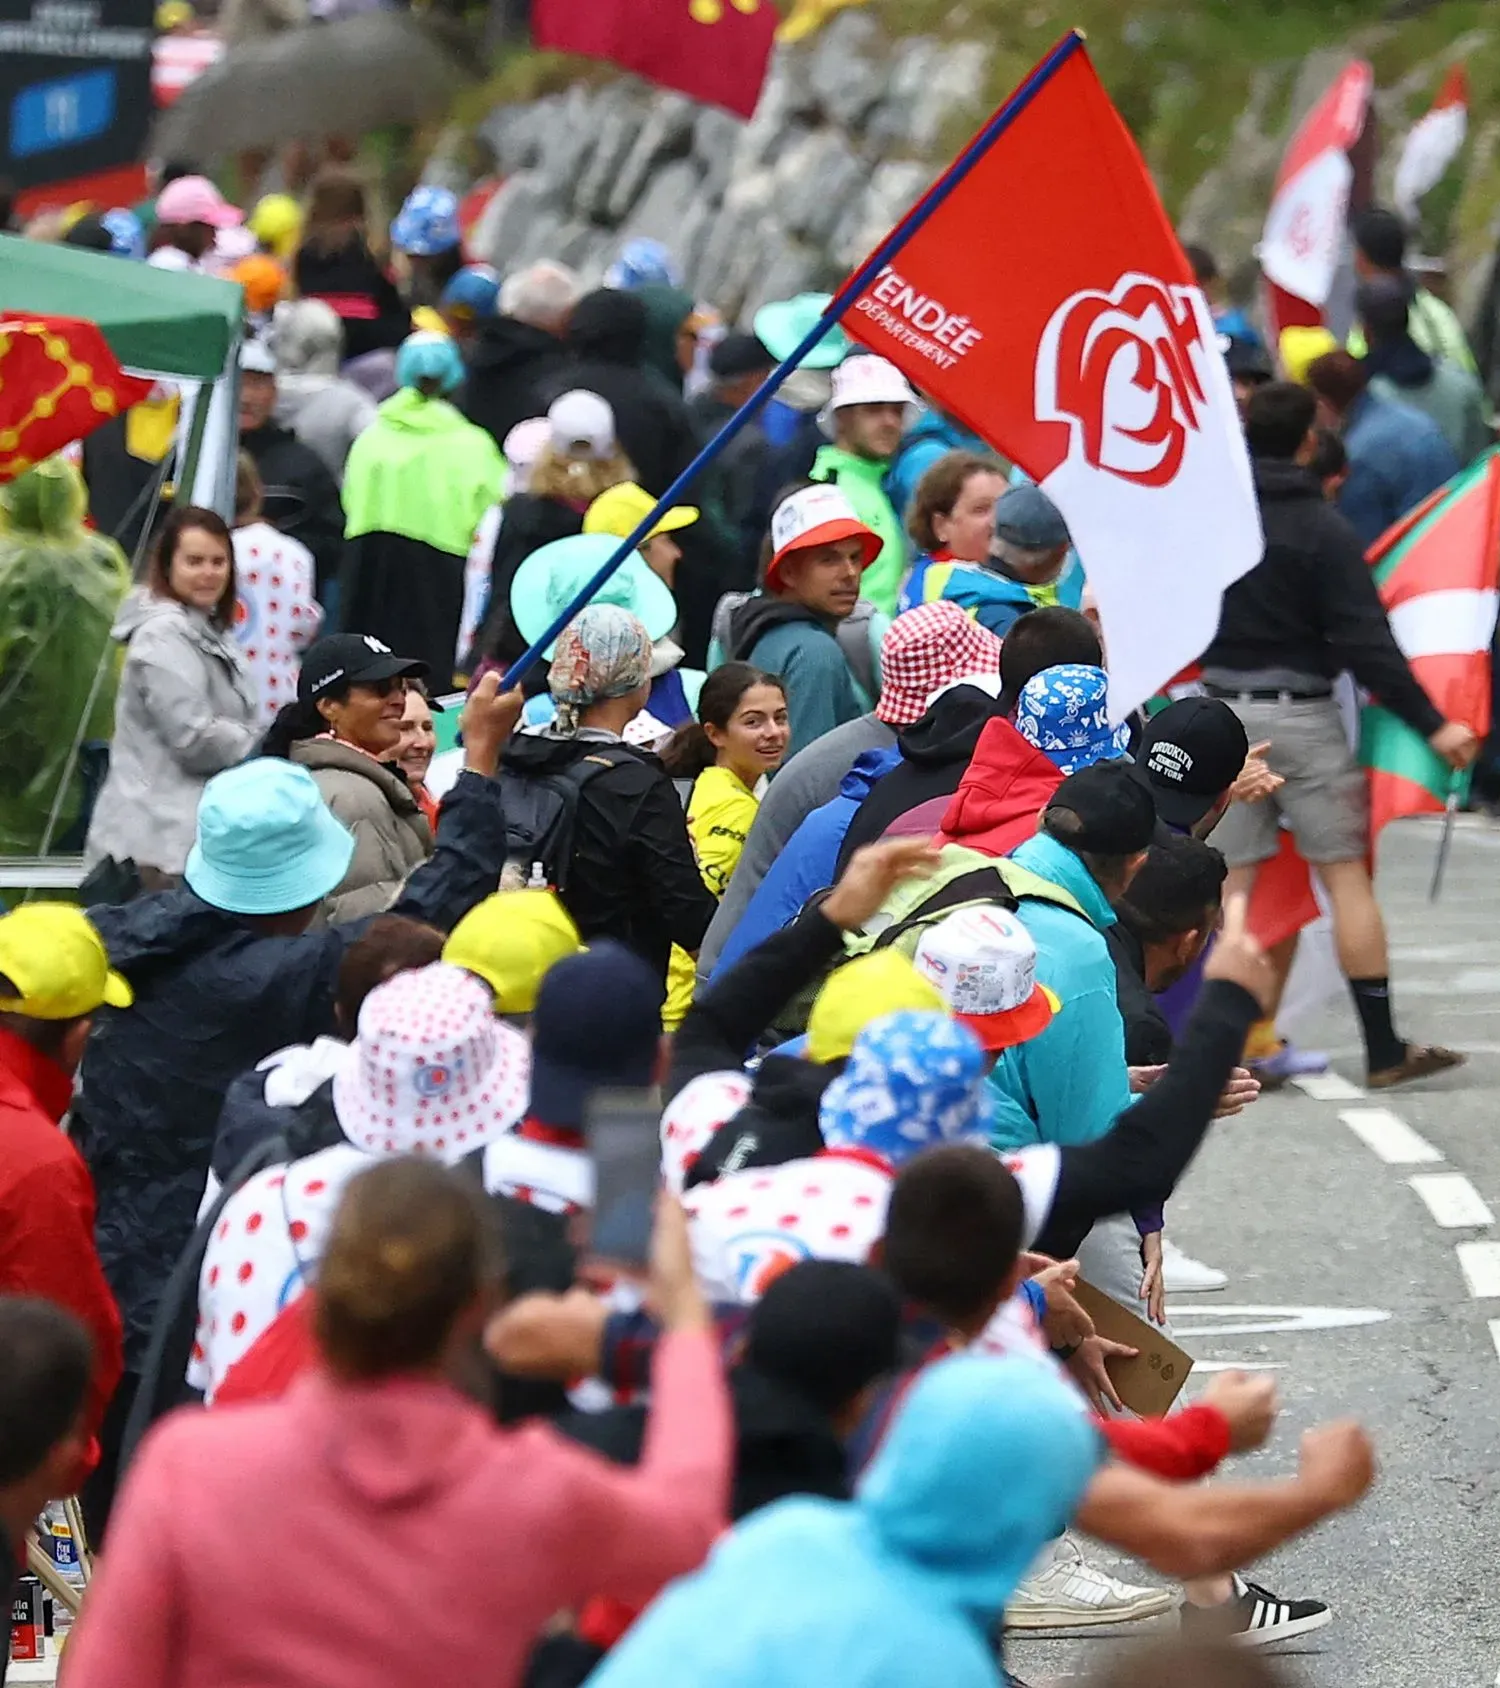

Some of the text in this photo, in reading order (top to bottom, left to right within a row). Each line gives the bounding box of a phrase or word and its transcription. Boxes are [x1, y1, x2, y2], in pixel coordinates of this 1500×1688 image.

[855, 299, 958, 370] DÉPARTEMENT
[1147, 758, 1164, 774] NEW
[1163, 766, 1185, 783] YORK
[1150, 740, 1194, 772] BROOKLYN
